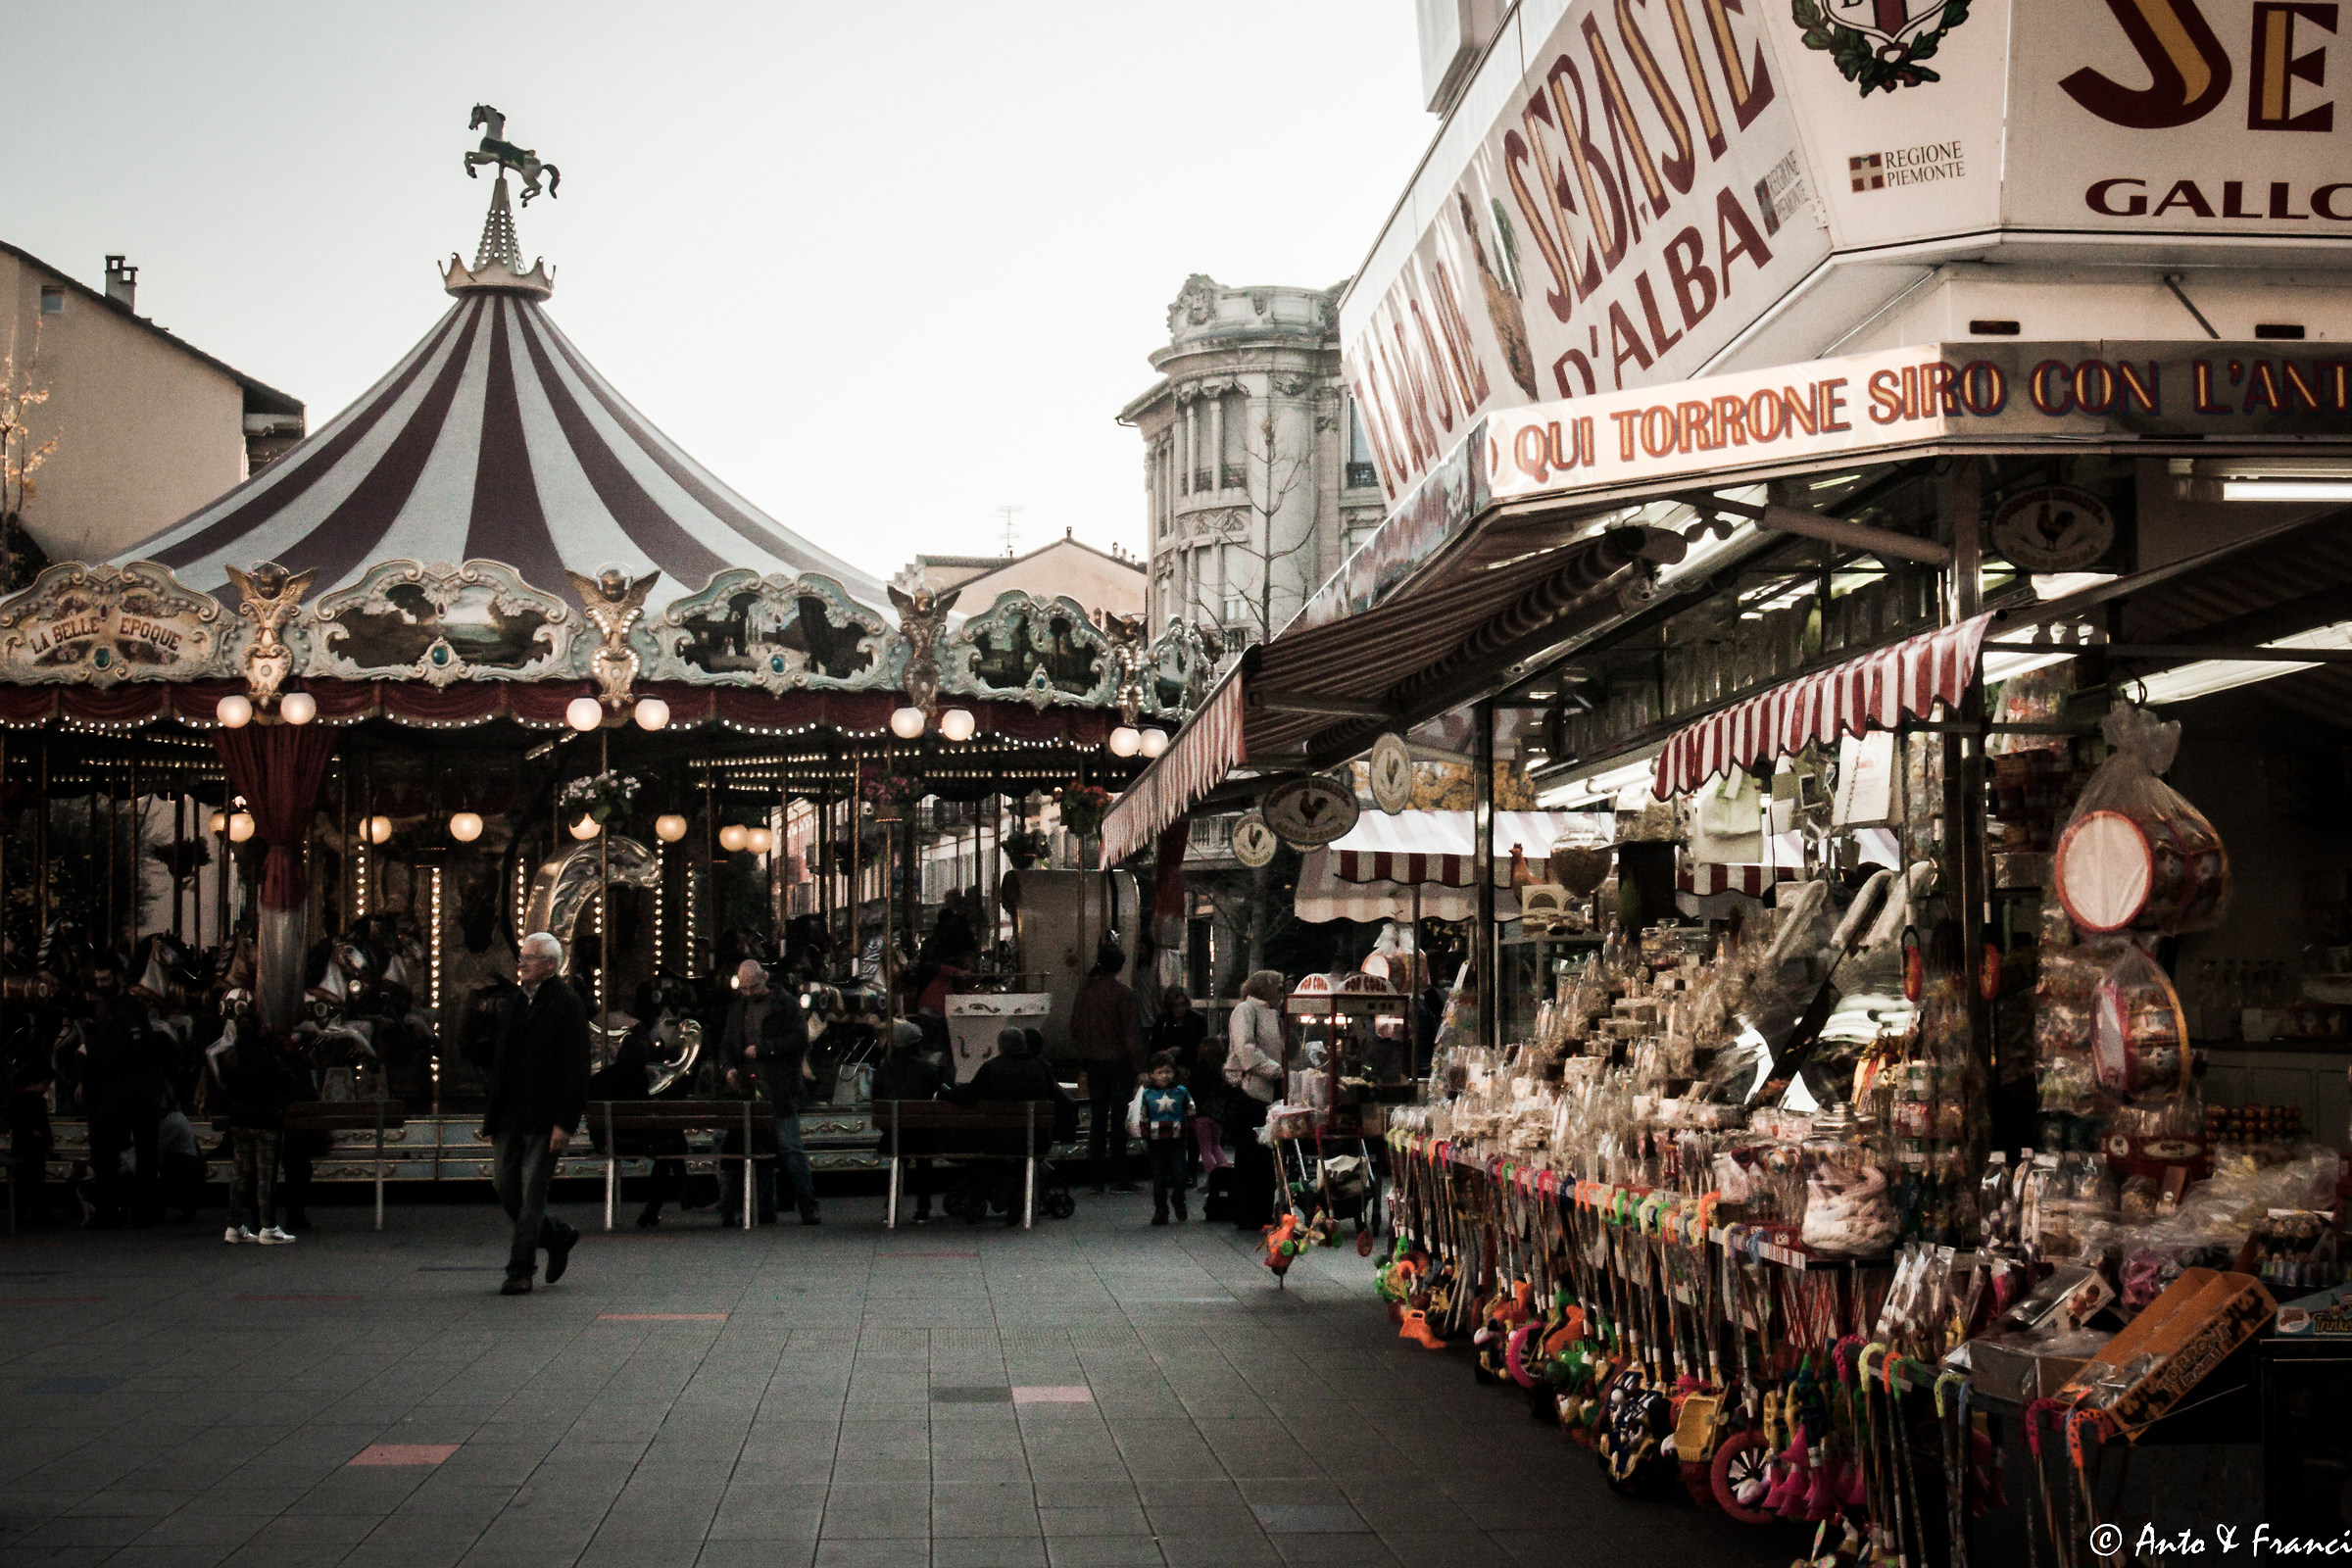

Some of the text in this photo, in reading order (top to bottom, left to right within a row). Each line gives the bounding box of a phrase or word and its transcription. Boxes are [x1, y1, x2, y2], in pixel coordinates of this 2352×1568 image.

[1766, 149, 1800, 199] REGIONE
[1885, 140, 1963, 169] REGIONE
[1886, 160, 1966, 188] PIEMONTE
[1552, 185, 1773, 398] D'ALBA
[1514, 416, 1595, 484] QUI
[1610, 378, 1851, 462] TORRONE
[1868, 359, 2005, 425] SIRO
[2029, 360, 2160, 417] CON
[29, 616, 183, 655] LA BELLE EPOQUE
